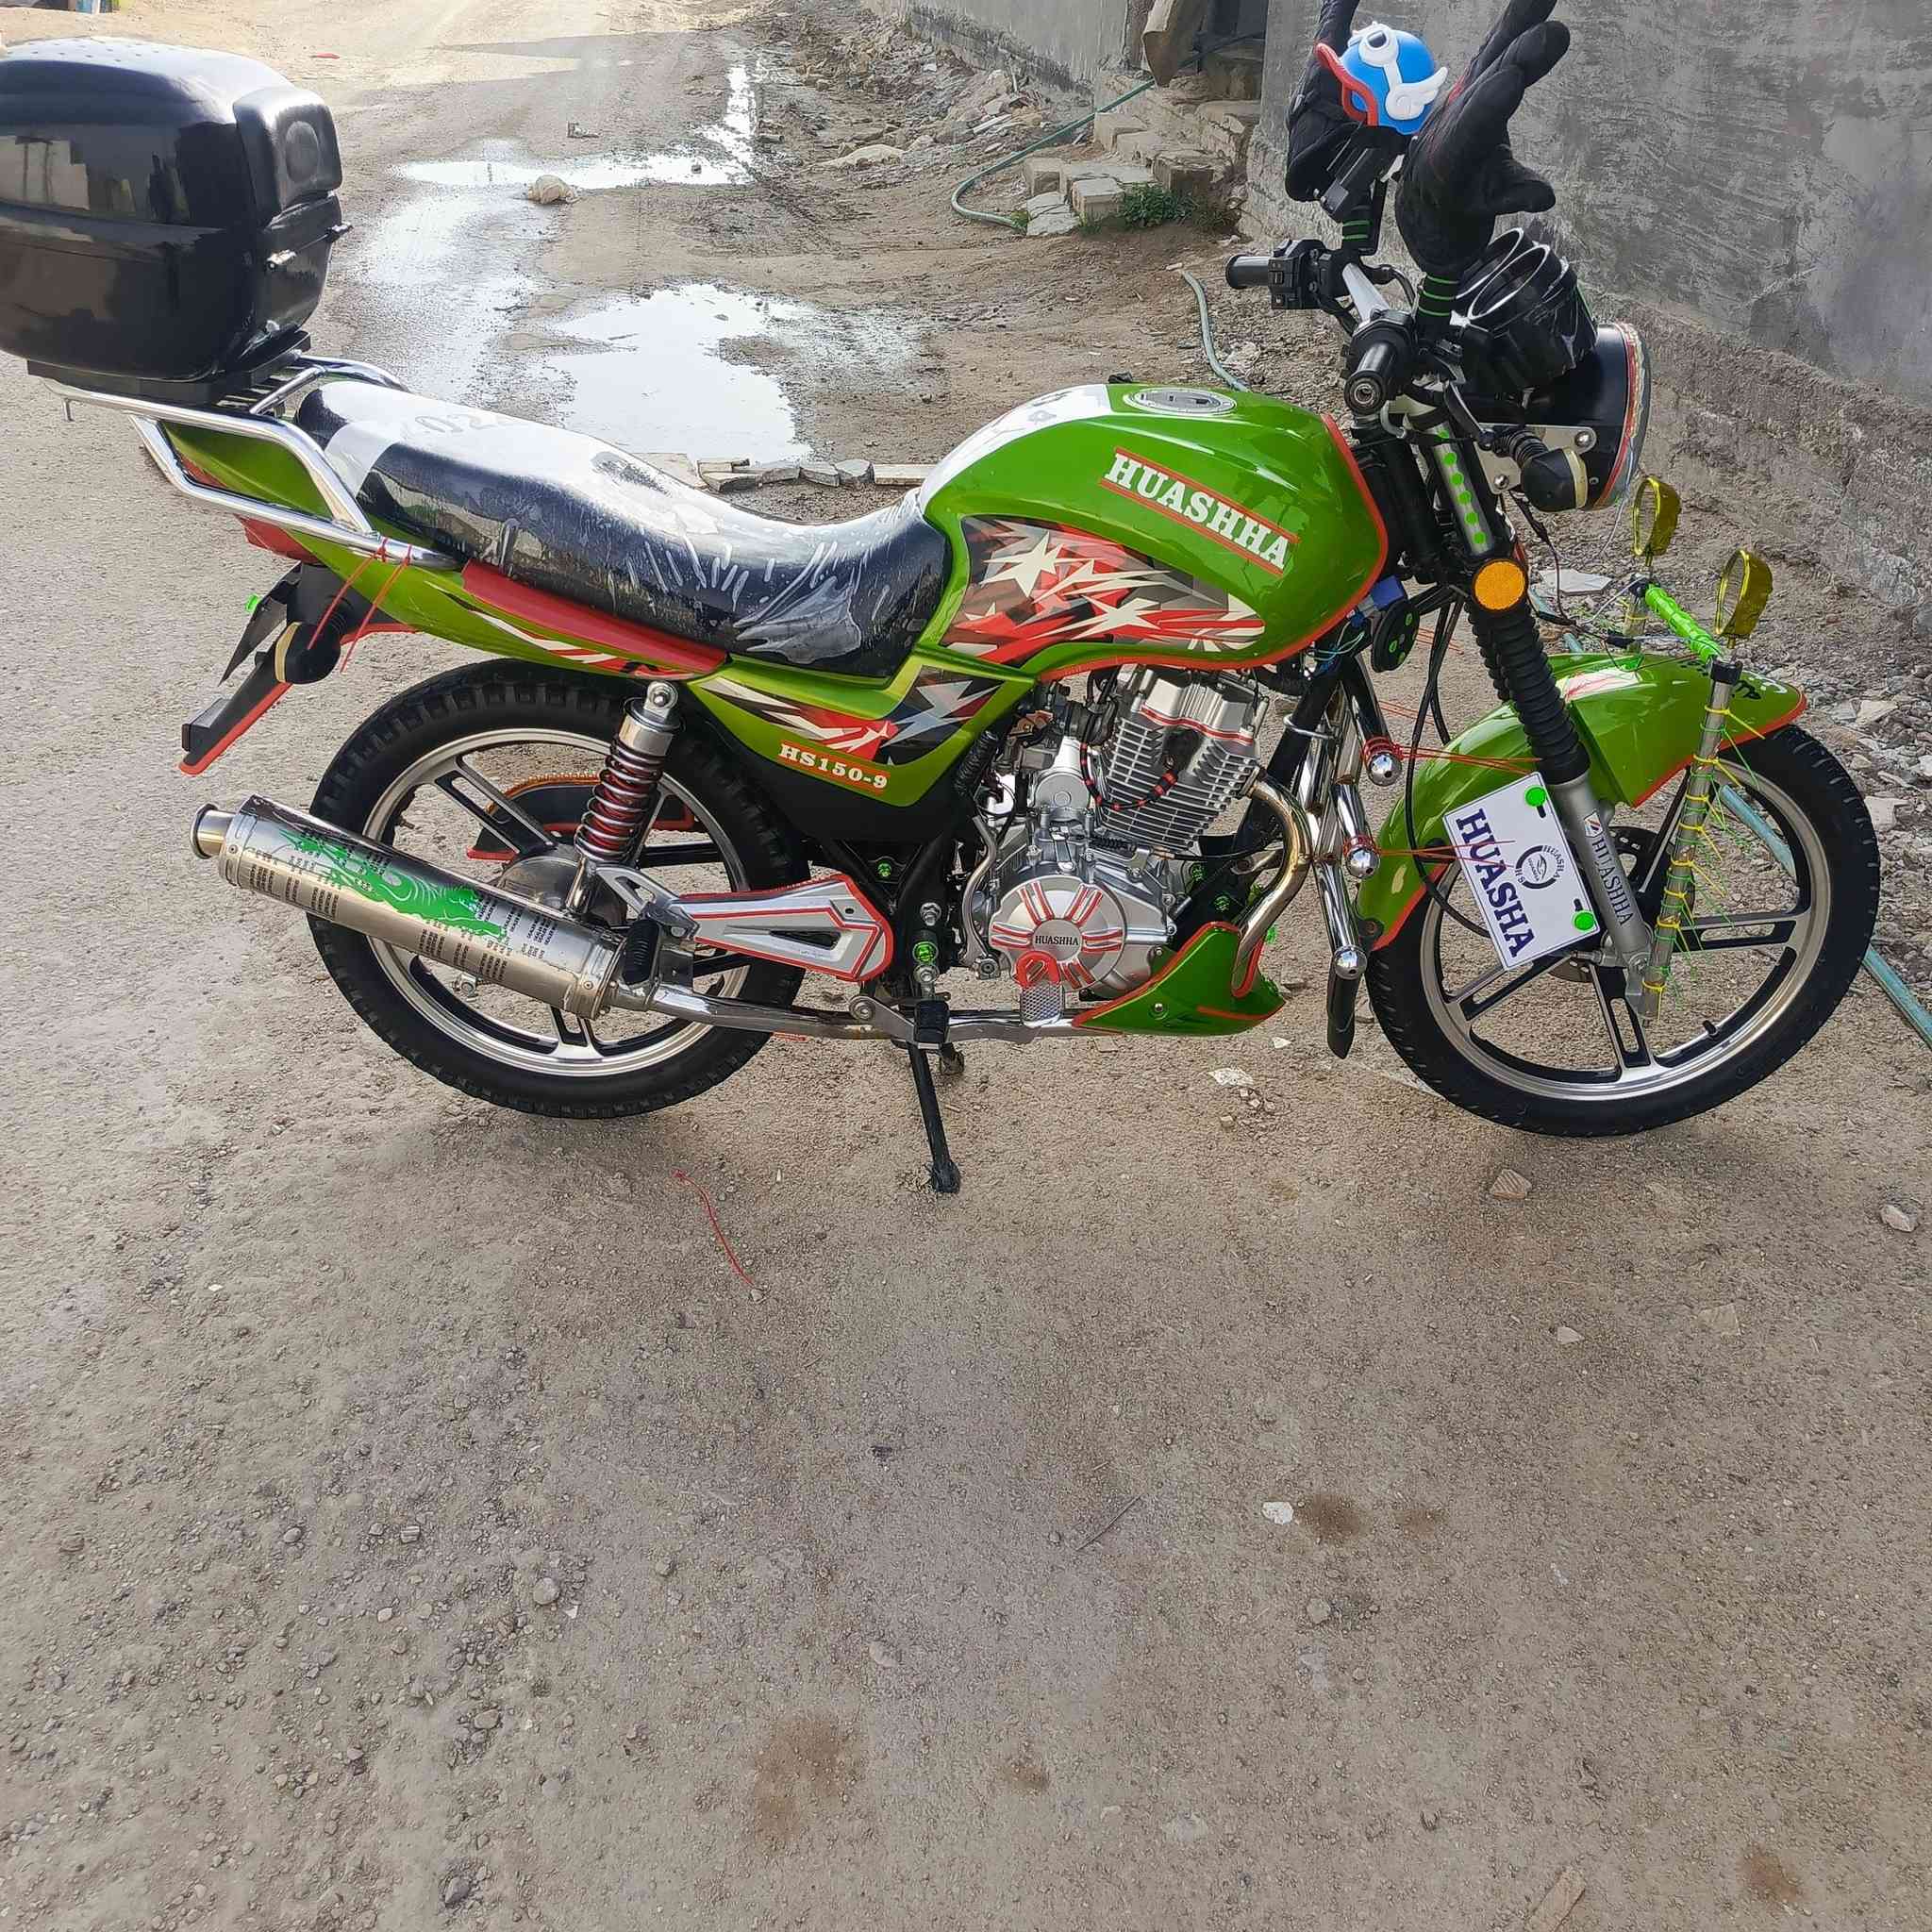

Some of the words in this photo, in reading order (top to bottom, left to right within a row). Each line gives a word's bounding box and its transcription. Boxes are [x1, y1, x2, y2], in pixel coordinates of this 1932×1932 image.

[1104, 454, 1291, 570] HUASHHA
[778, 743, 889, 790] HS150-9
[1456, 808, 1535, 958] HUASHA
[1591, 838, 1634, 926] HUASHHA
[1035, 935, 1079, 946] HUASHHA
